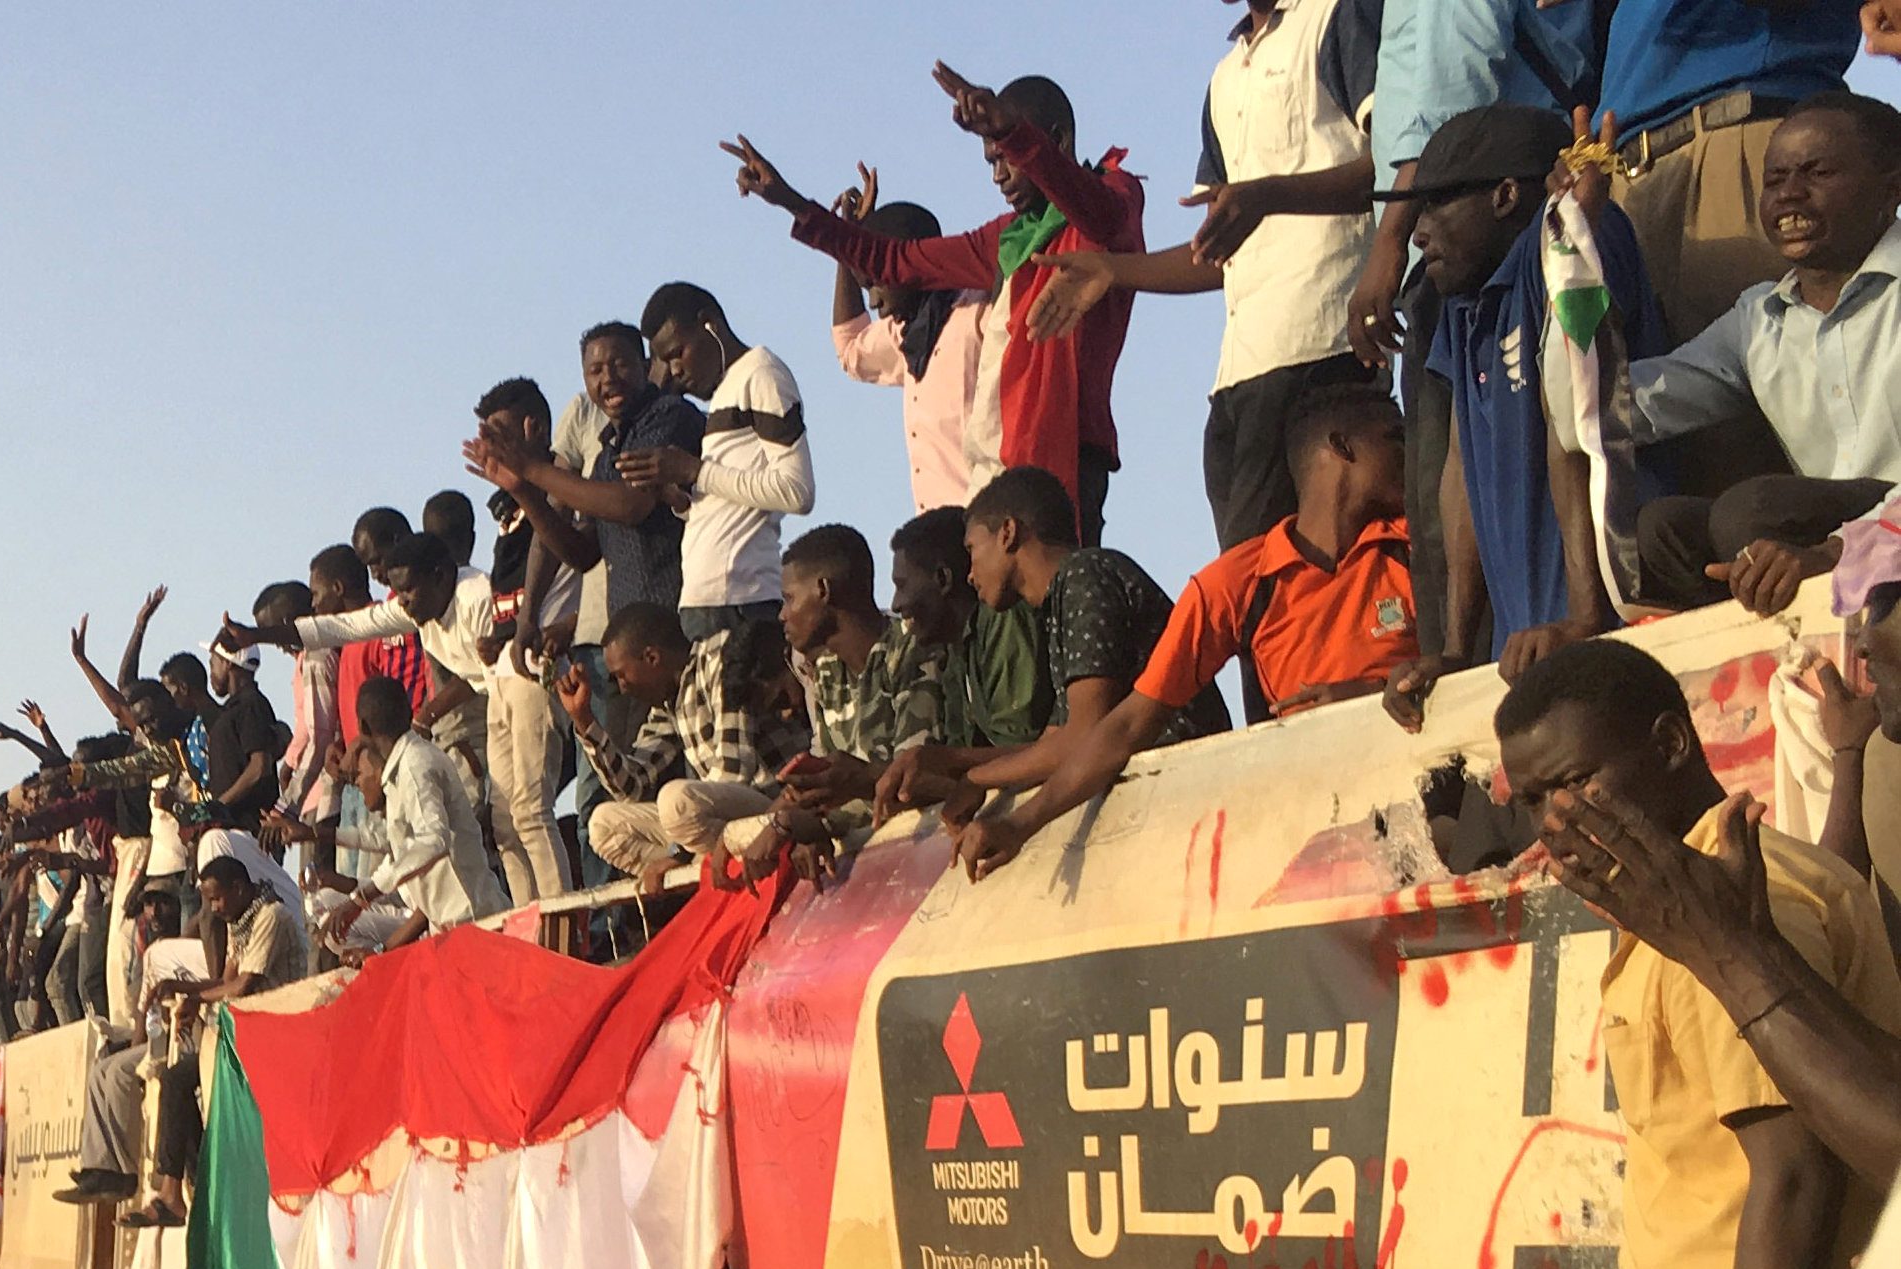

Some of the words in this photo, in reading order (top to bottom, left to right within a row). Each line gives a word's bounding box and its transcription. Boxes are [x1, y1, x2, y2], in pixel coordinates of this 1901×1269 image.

[1064, 997, 1368, 1134] سنوات
[932, 1160, 1020, 1190] MITSUBISHI
[947, 1196, 1008, 1226] MOTORS
[1067, 1126, 1358, 1258] ضمان
